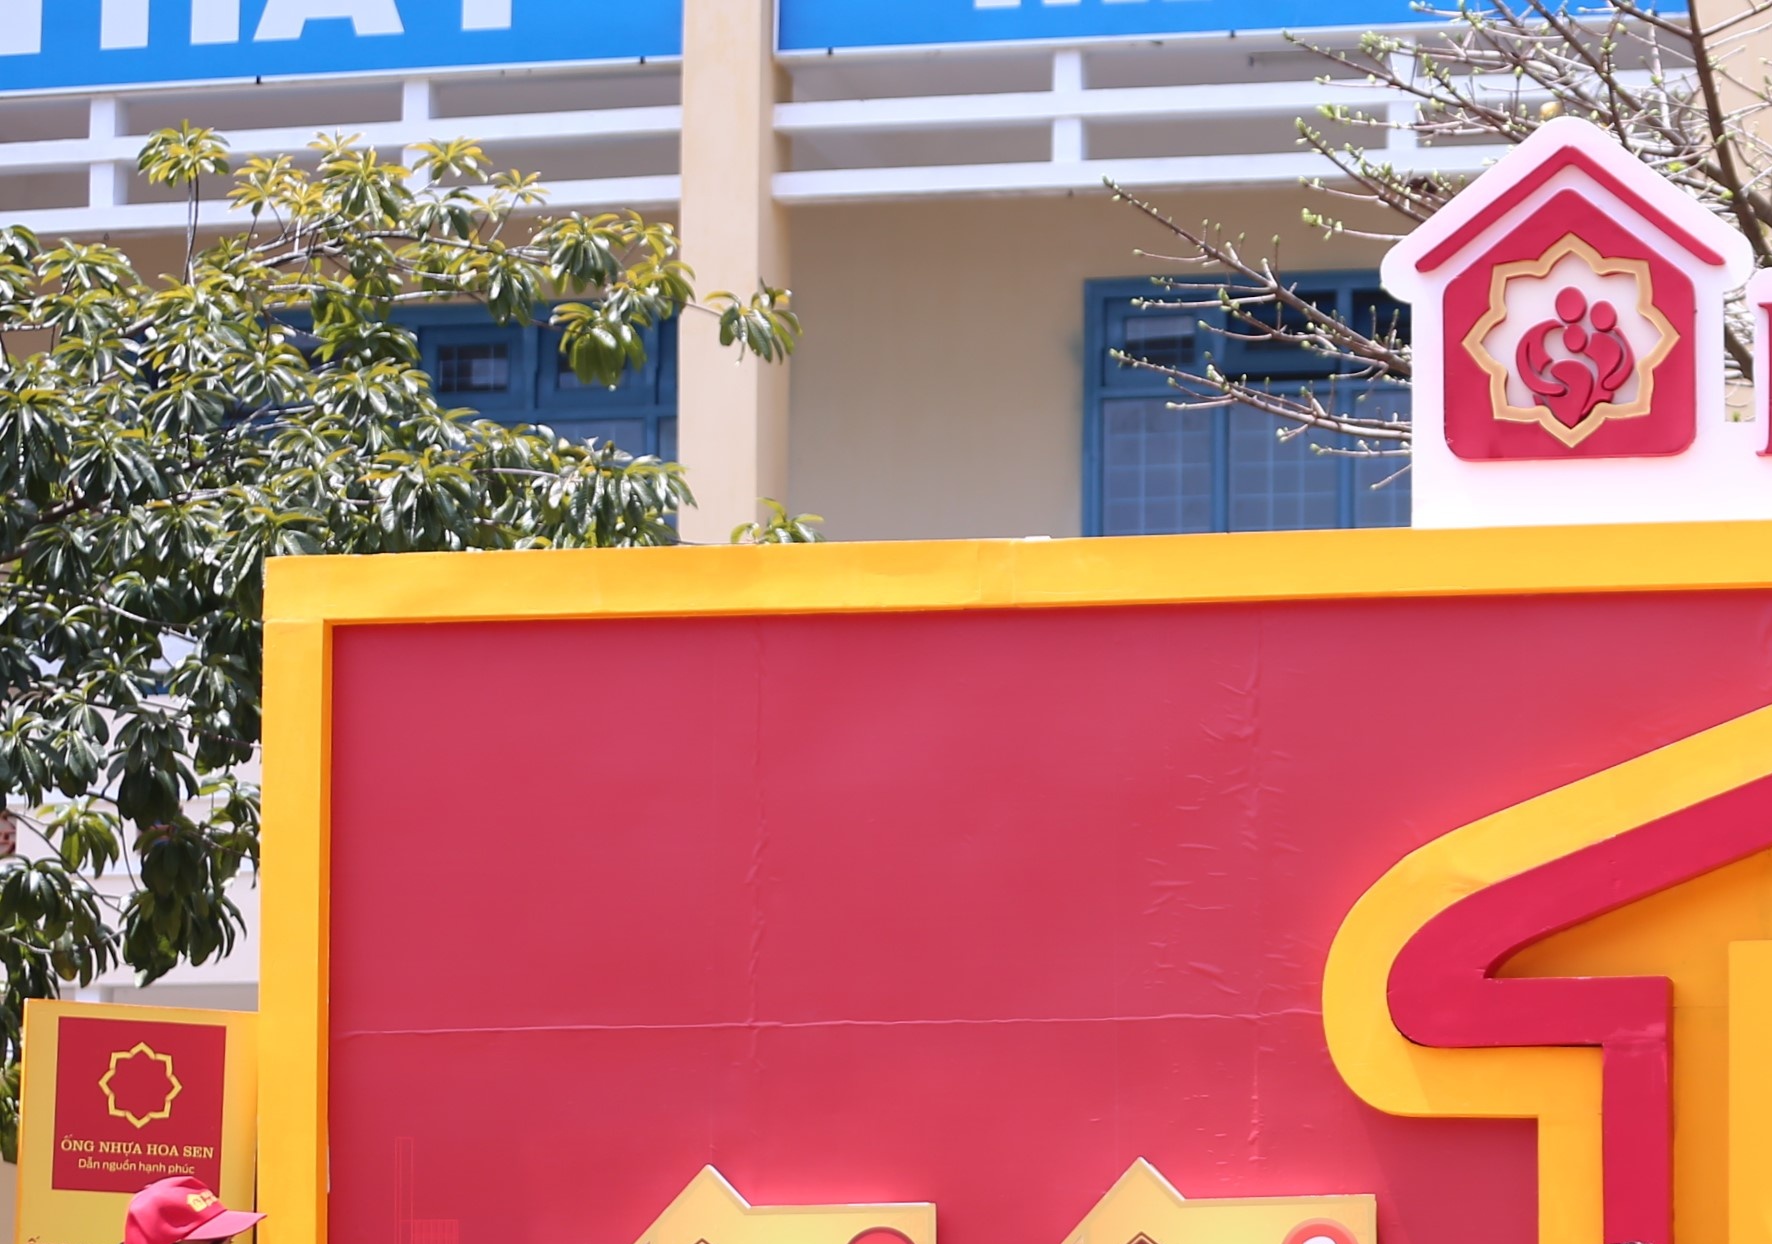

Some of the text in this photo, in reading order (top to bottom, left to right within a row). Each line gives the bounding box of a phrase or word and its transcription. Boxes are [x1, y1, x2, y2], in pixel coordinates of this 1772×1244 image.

[61, 1133, 214, 1159] ỐNG NHỰA HOA SEN
[138, 1161, 166, 1175] hạnh
[168, 1162, 195, 1175] phúc
